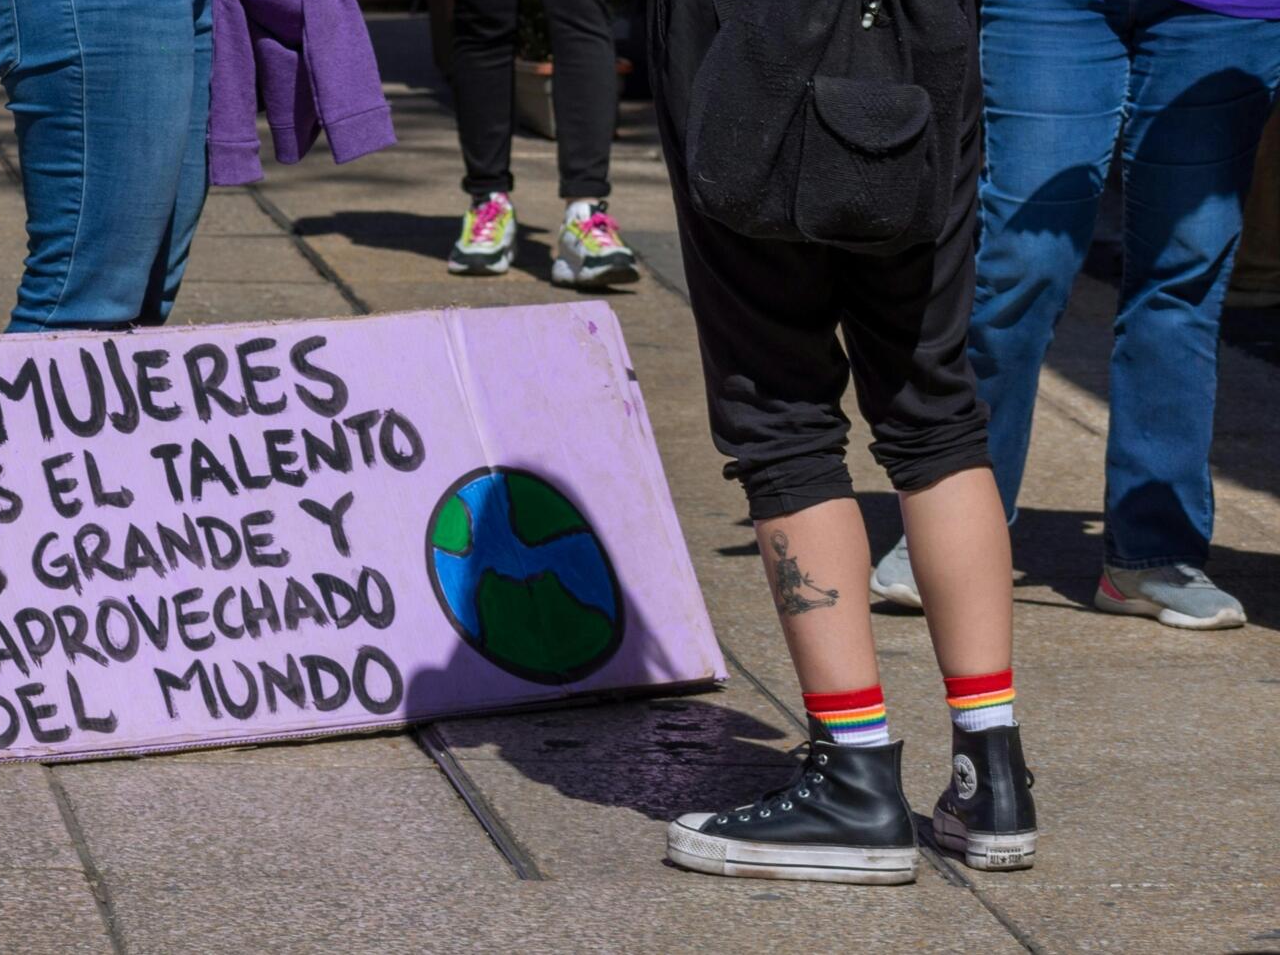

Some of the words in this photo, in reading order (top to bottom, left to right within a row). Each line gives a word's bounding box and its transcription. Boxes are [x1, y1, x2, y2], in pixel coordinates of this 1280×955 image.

[42, 449, 135, 519] EL
[150, 408, 426, 504] TALENTO
[31, 509, 291, 596] GRANDE
[298, 491, 354, 557] Y
[153, 645, 404, 720] MUNDO
